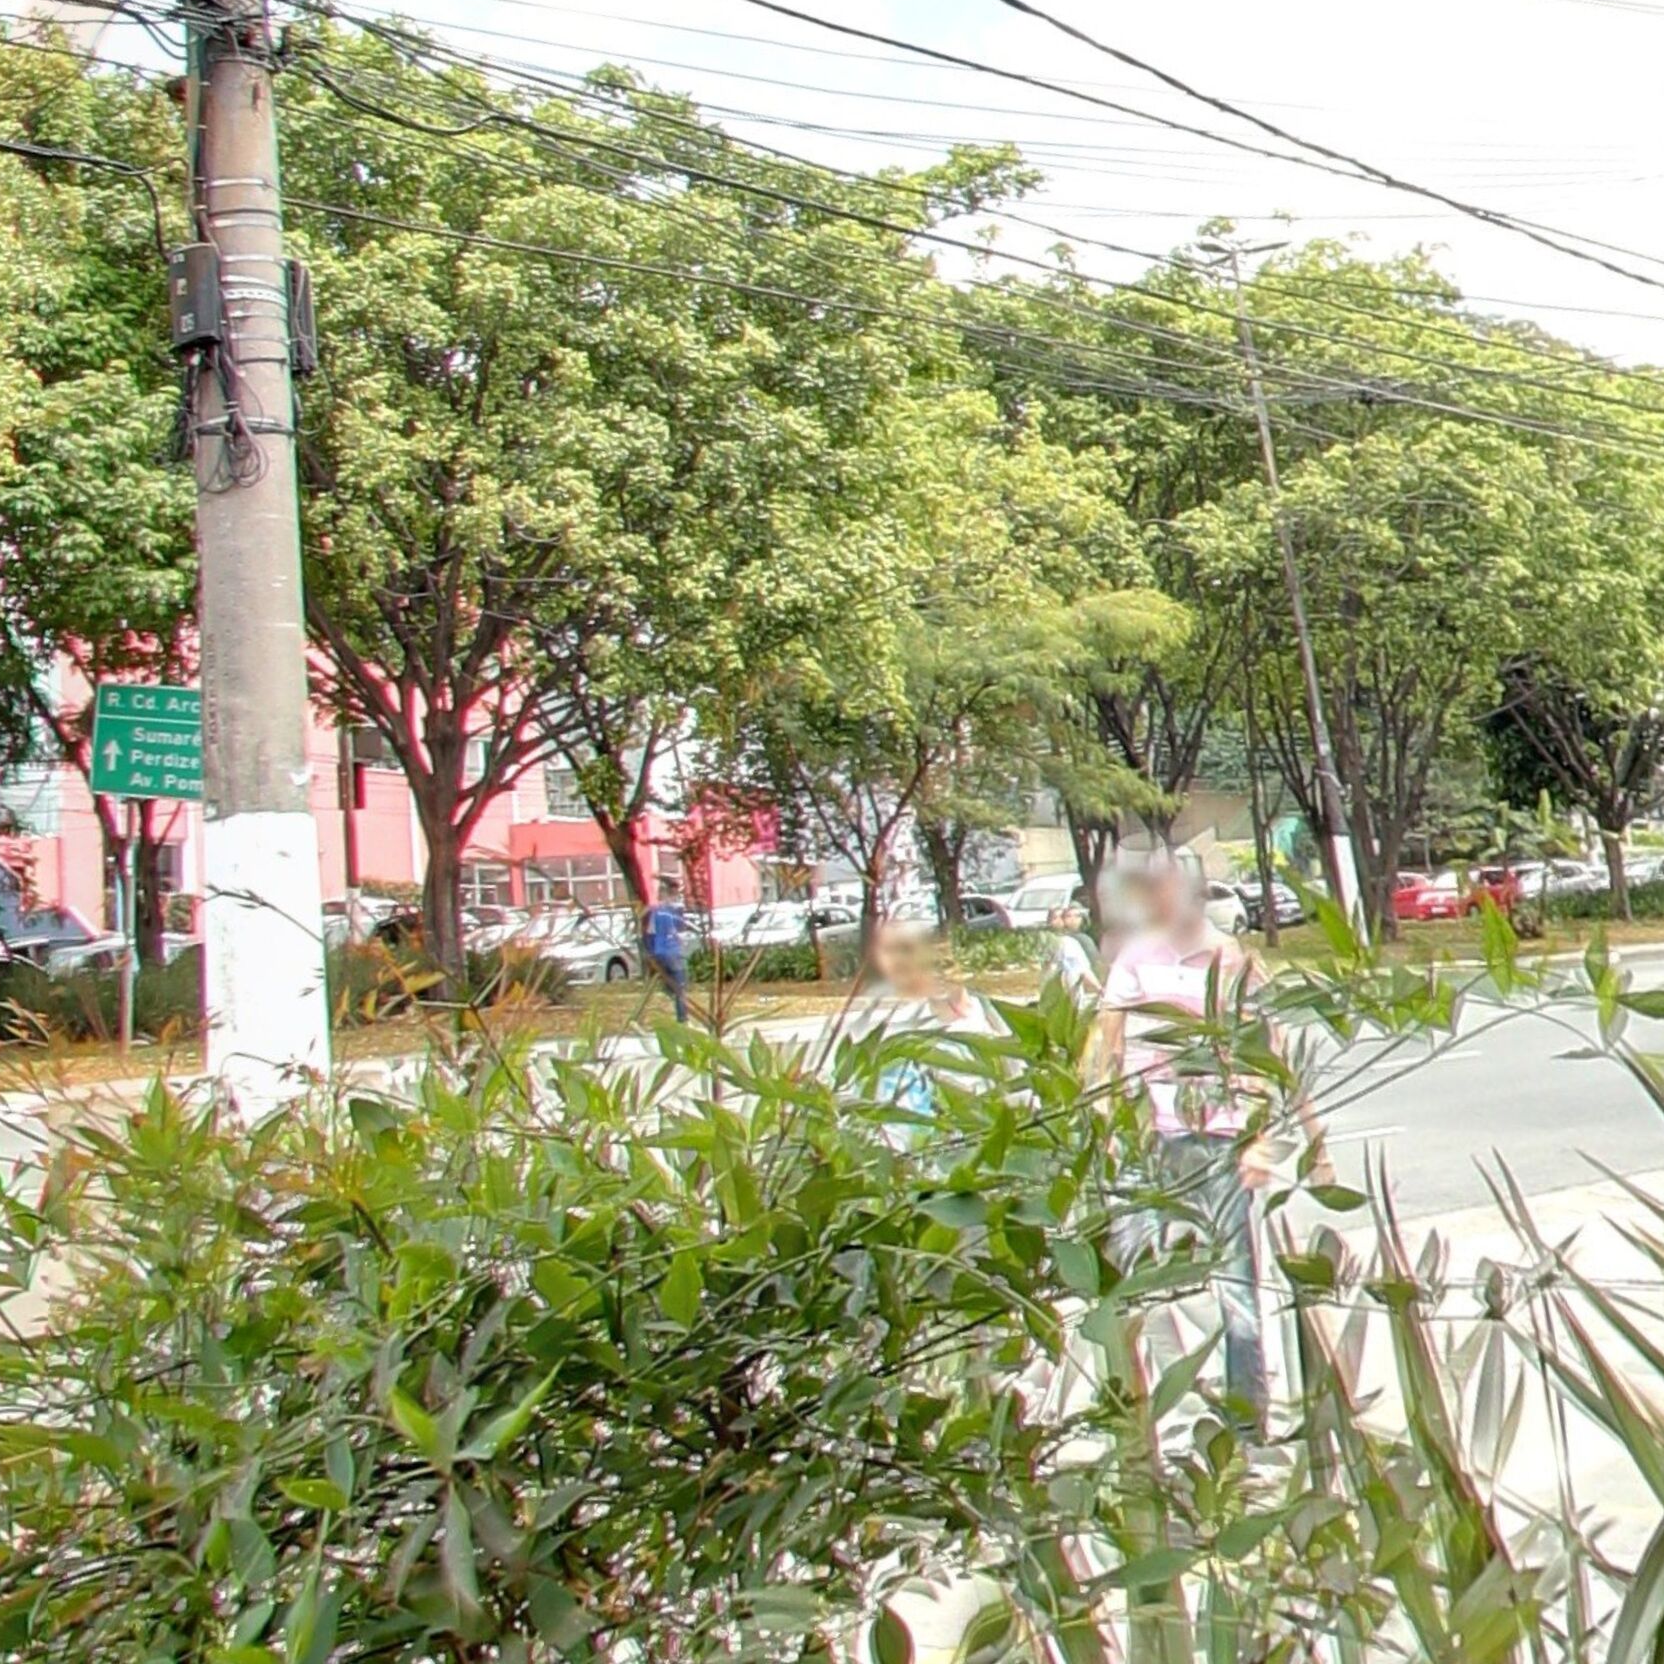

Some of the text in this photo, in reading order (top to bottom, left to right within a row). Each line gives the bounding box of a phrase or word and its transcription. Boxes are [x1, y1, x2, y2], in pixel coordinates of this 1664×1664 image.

[106, 692, 201, 713] R. Cd. Arc
[133, 727, 202, 747] Sumaré
[130, 750, 201, 769] Perdize
[130, 772, 203, 791] Av. Pom
